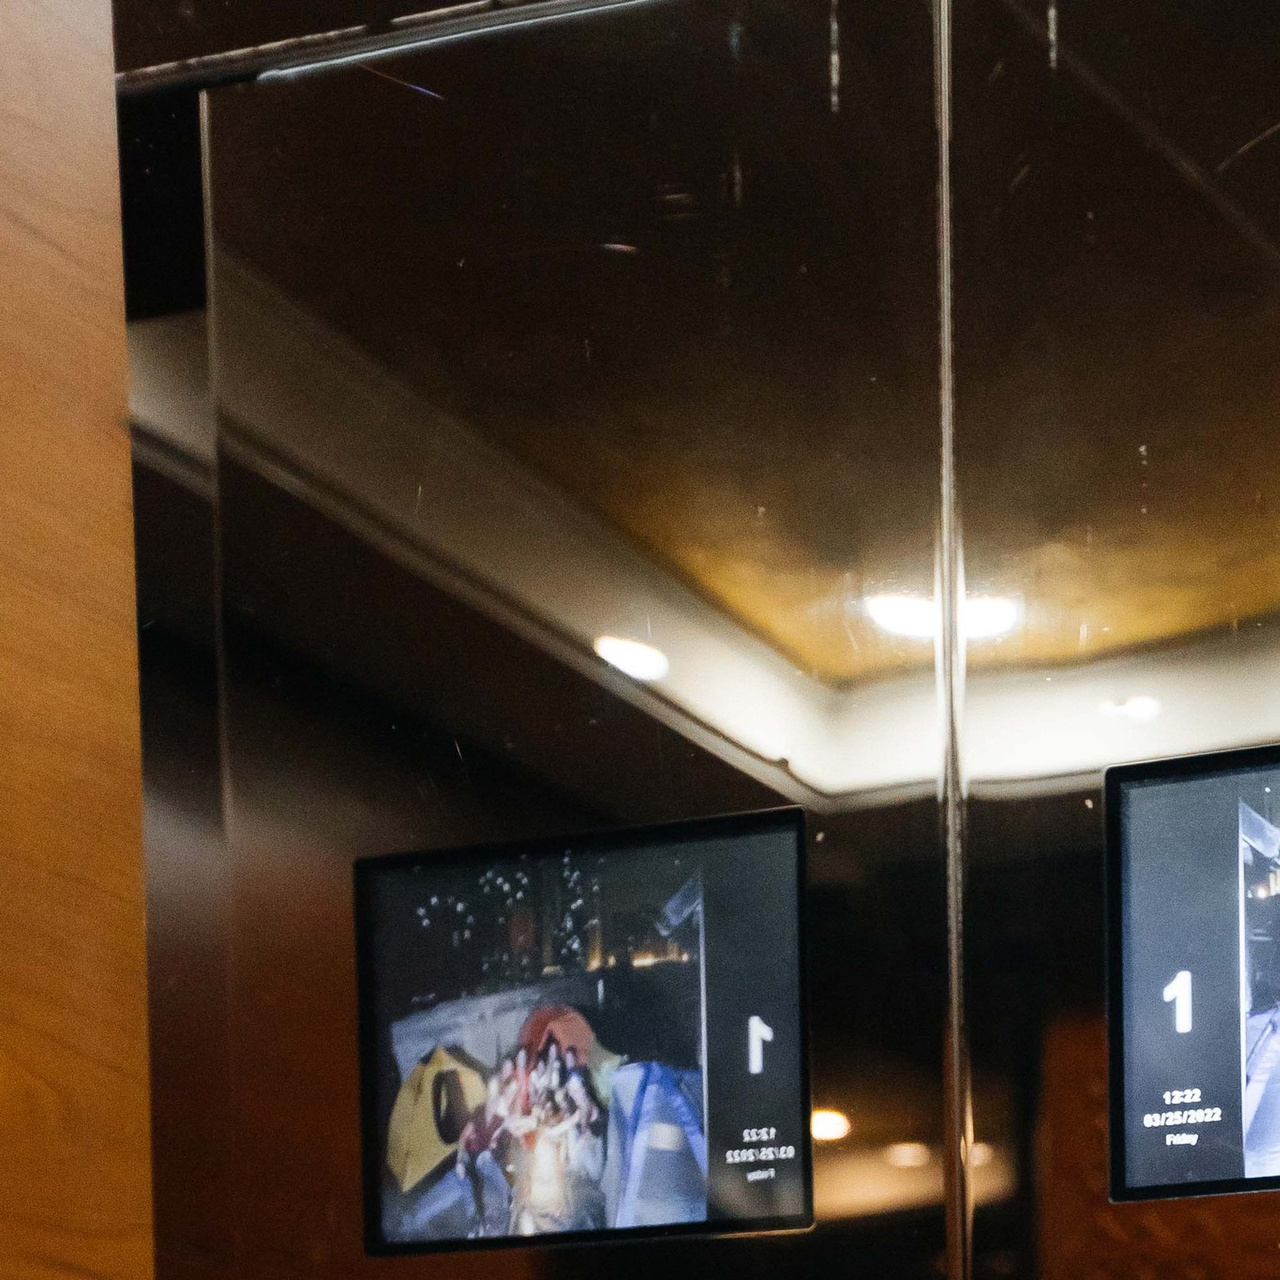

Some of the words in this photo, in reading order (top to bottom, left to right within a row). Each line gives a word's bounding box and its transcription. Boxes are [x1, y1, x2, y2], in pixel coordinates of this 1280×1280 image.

[1161, 970, 1193, 1034] 1
[1162, 1088, 1202, 1105] 12:22
[1143, 1107, 1222, 1128] 03/25/2022
